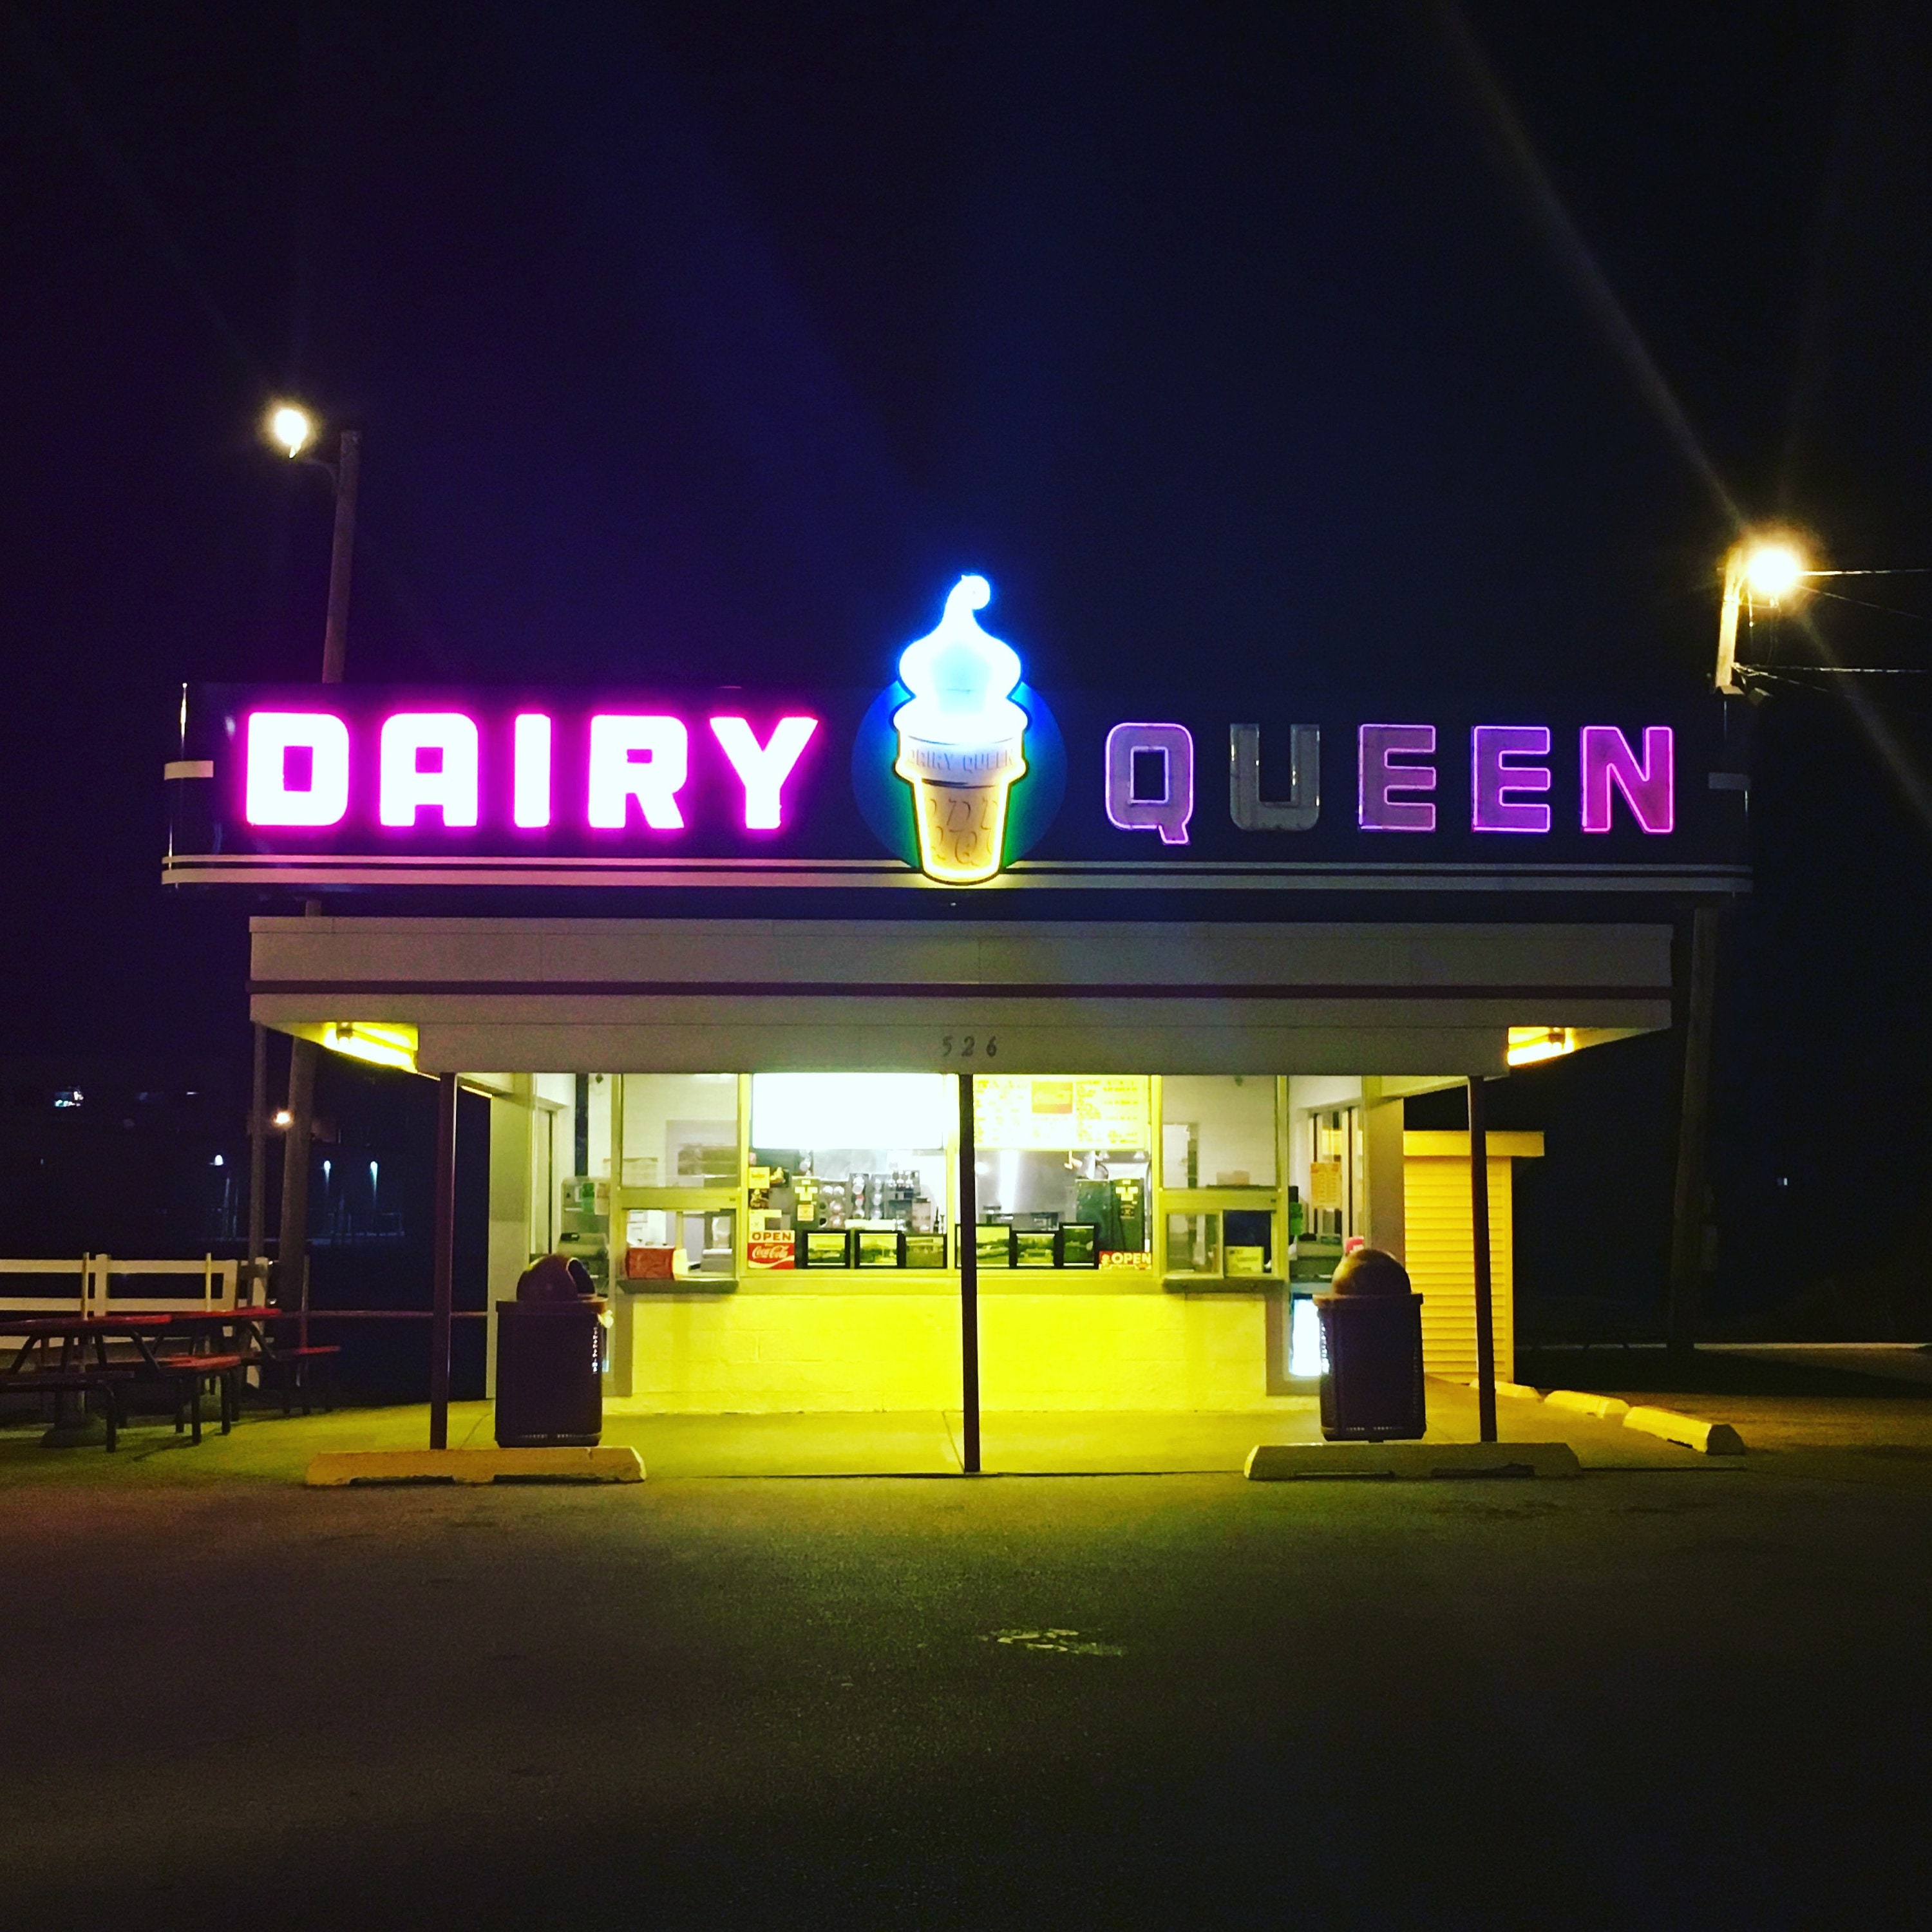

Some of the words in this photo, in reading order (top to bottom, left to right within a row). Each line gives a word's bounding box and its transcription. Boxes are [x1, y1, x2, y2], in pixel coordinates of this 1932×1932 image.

[246, 712, 818, 829] DAIRY
[1105, 723, 1674, 844] QUEEN
[942, 1035, 997, 1057] 526
[752, 1231, 791, 1241] OPEN
[1111, 1252, 1151, 1264] OPEN
